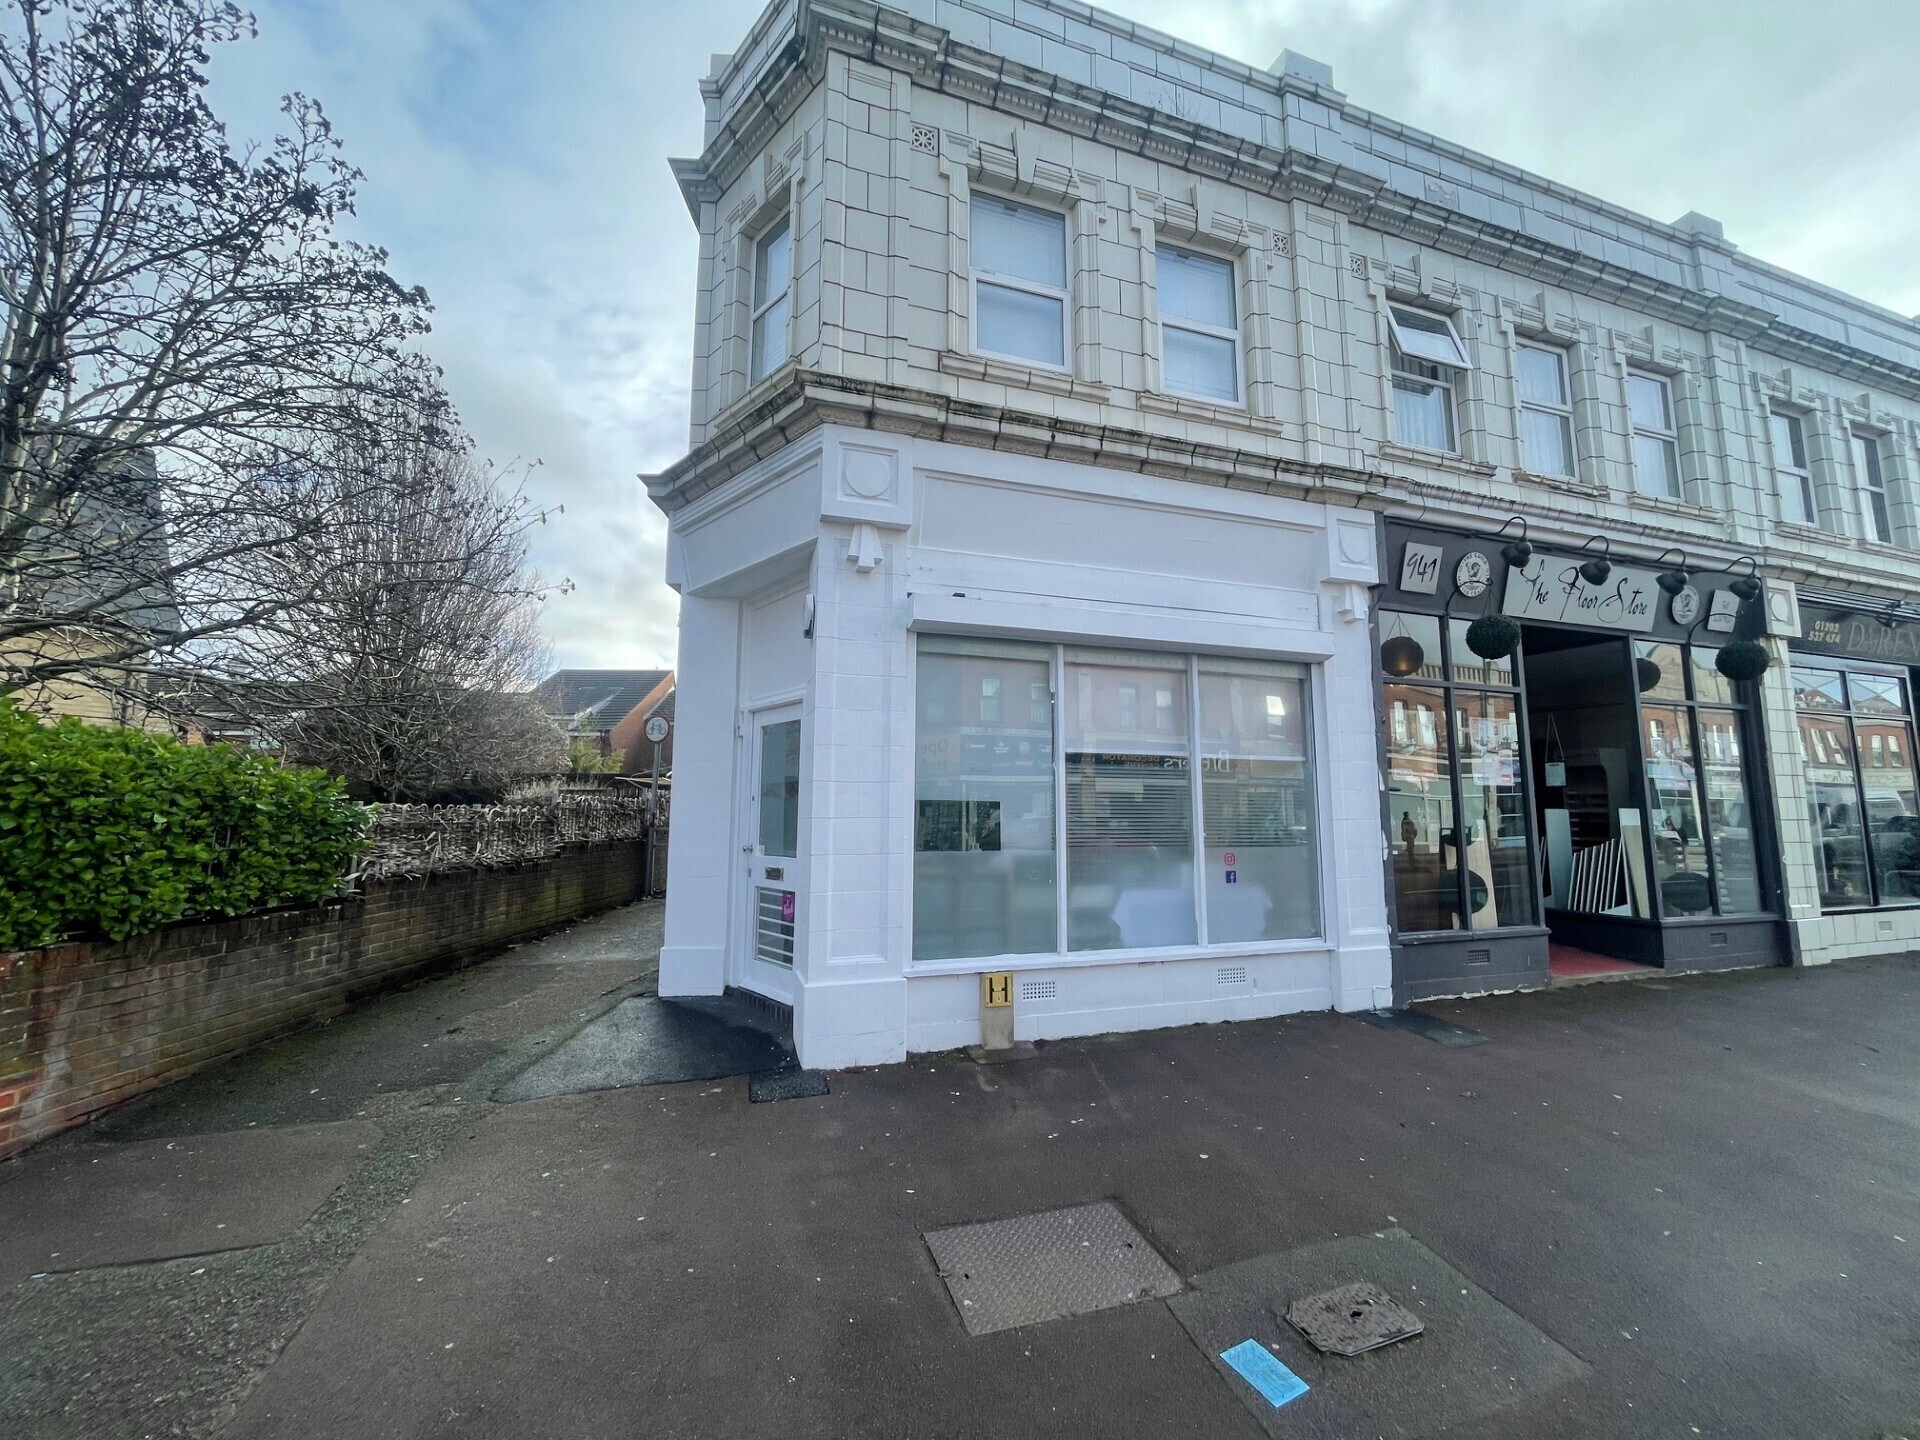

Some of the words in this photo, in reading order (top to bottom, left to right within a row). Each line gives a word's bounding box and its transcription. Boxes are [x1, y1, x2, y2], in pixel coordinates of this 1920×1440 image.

[1407, 553, 1438, 583] 941
[1520, 559, 1549, 614] The
[1558, 567, 1598, 620] Floor
[1597, 577, 1647, 623] Store
[1814, 620, 1839, 633] 01202
[989, 976, 1008, 1004] H
